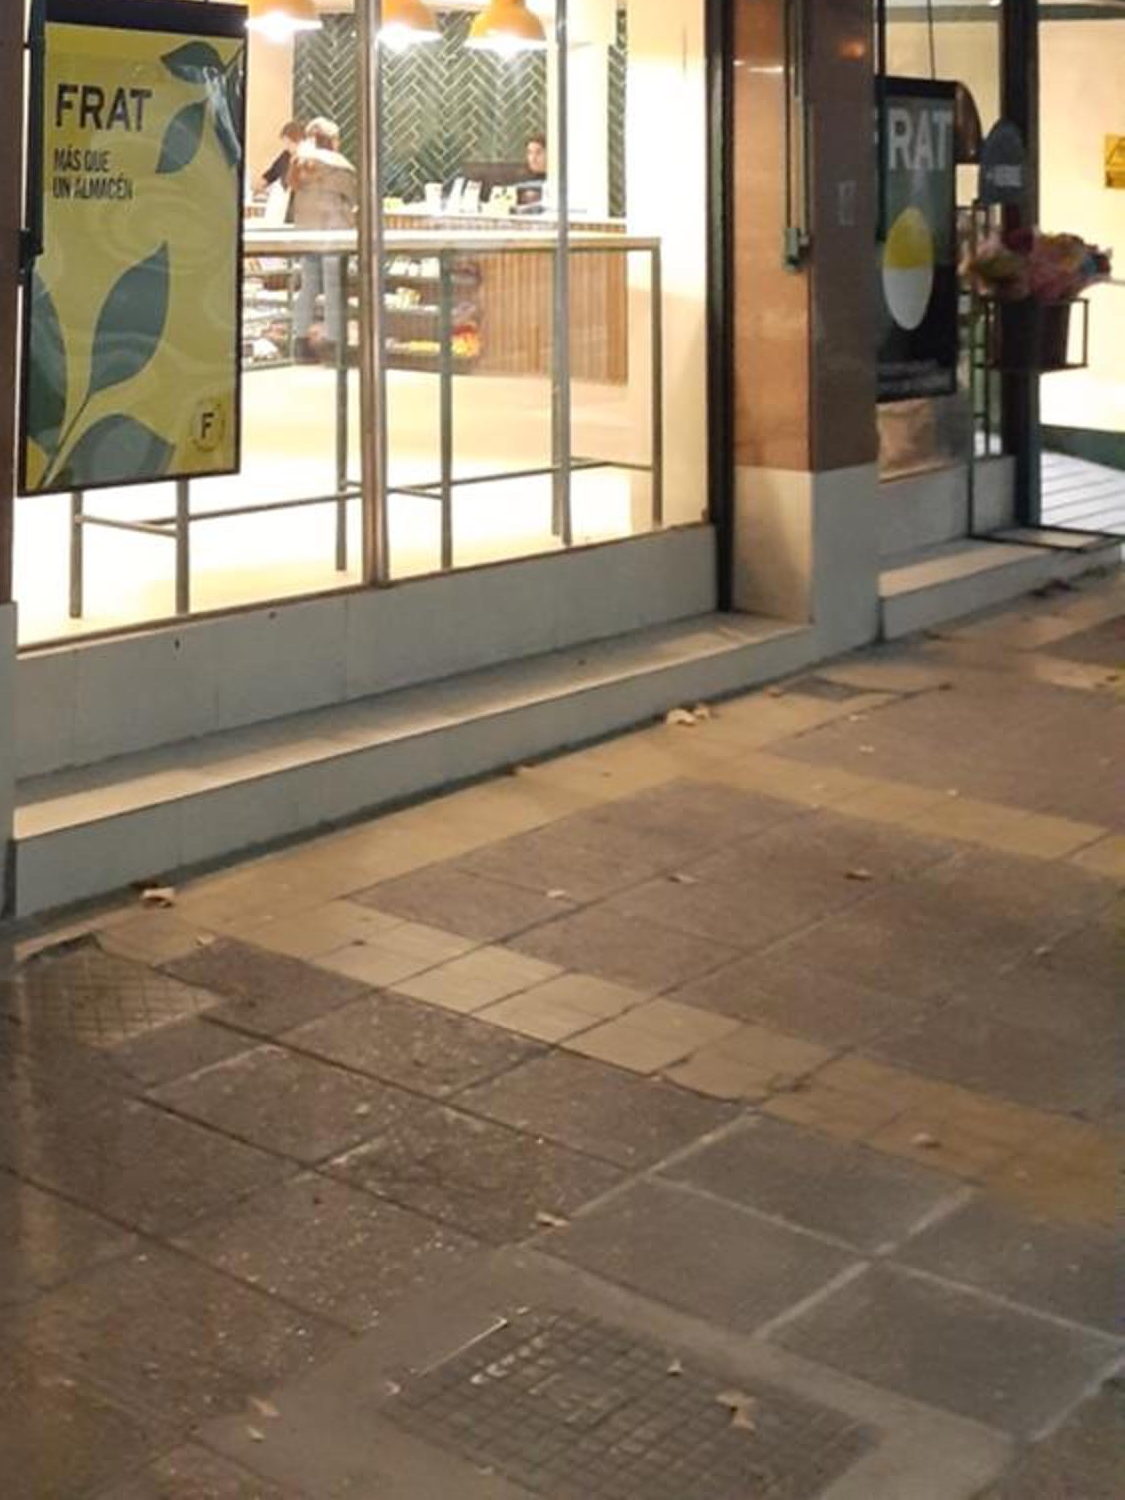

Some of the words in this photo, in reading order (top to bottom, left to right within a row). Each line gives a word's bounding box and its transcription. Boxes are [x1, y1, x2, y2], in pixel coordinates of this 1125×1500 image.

[56, 83, 153, 132] FRAT
[874, 107, 955, 171] RAT
[53, 144, 81, 172] MÁS
[84, 149, 111, 173] QUE
[53, 176, 71, 199] UN
[73, 172, 134, 200] ALMACÉN
[201, 411, 215, 440] F
